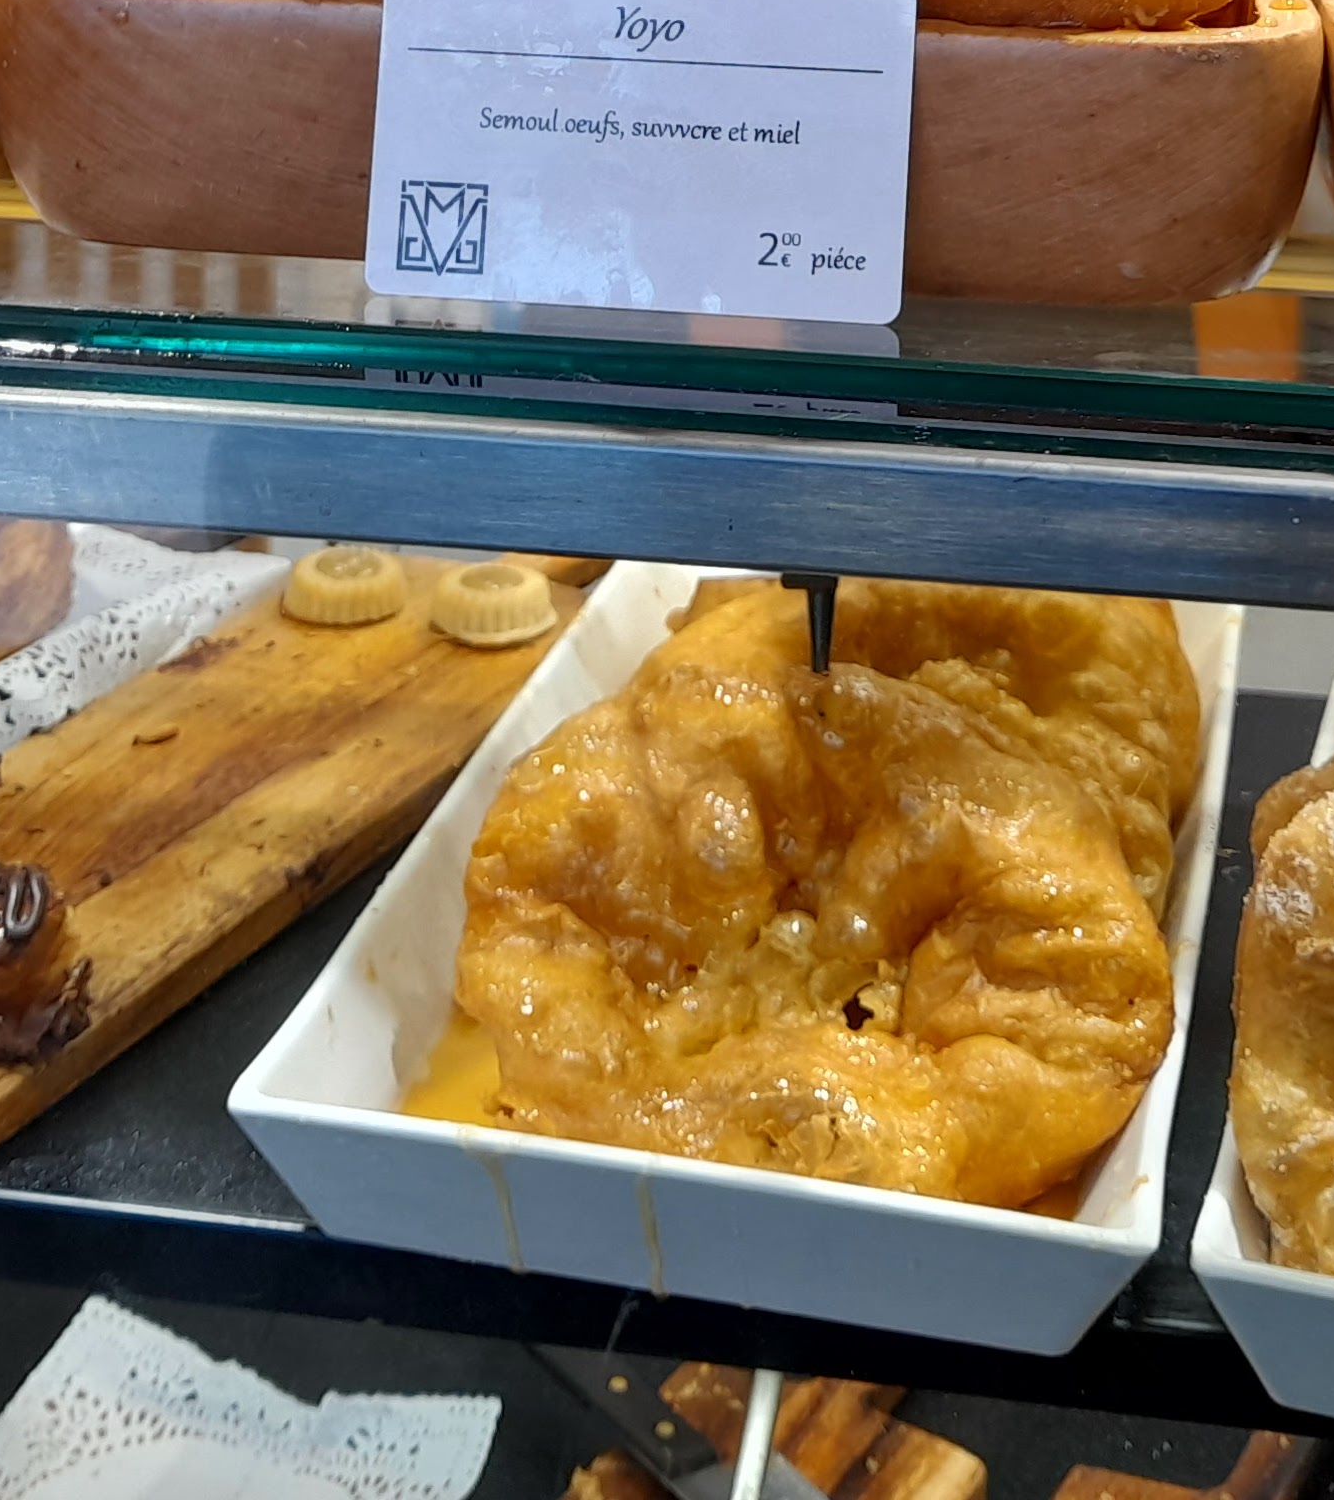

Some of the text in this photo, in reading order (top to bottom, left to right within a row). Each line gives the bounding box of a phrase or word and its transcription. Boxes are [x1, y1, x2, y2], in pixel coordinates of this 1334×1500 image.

[614, 5, 685, 52] Yoyo
[728, 122, 749, 142] et
[753, 120, 801, 145] miel
[810, 246, 867, 276] piéce
